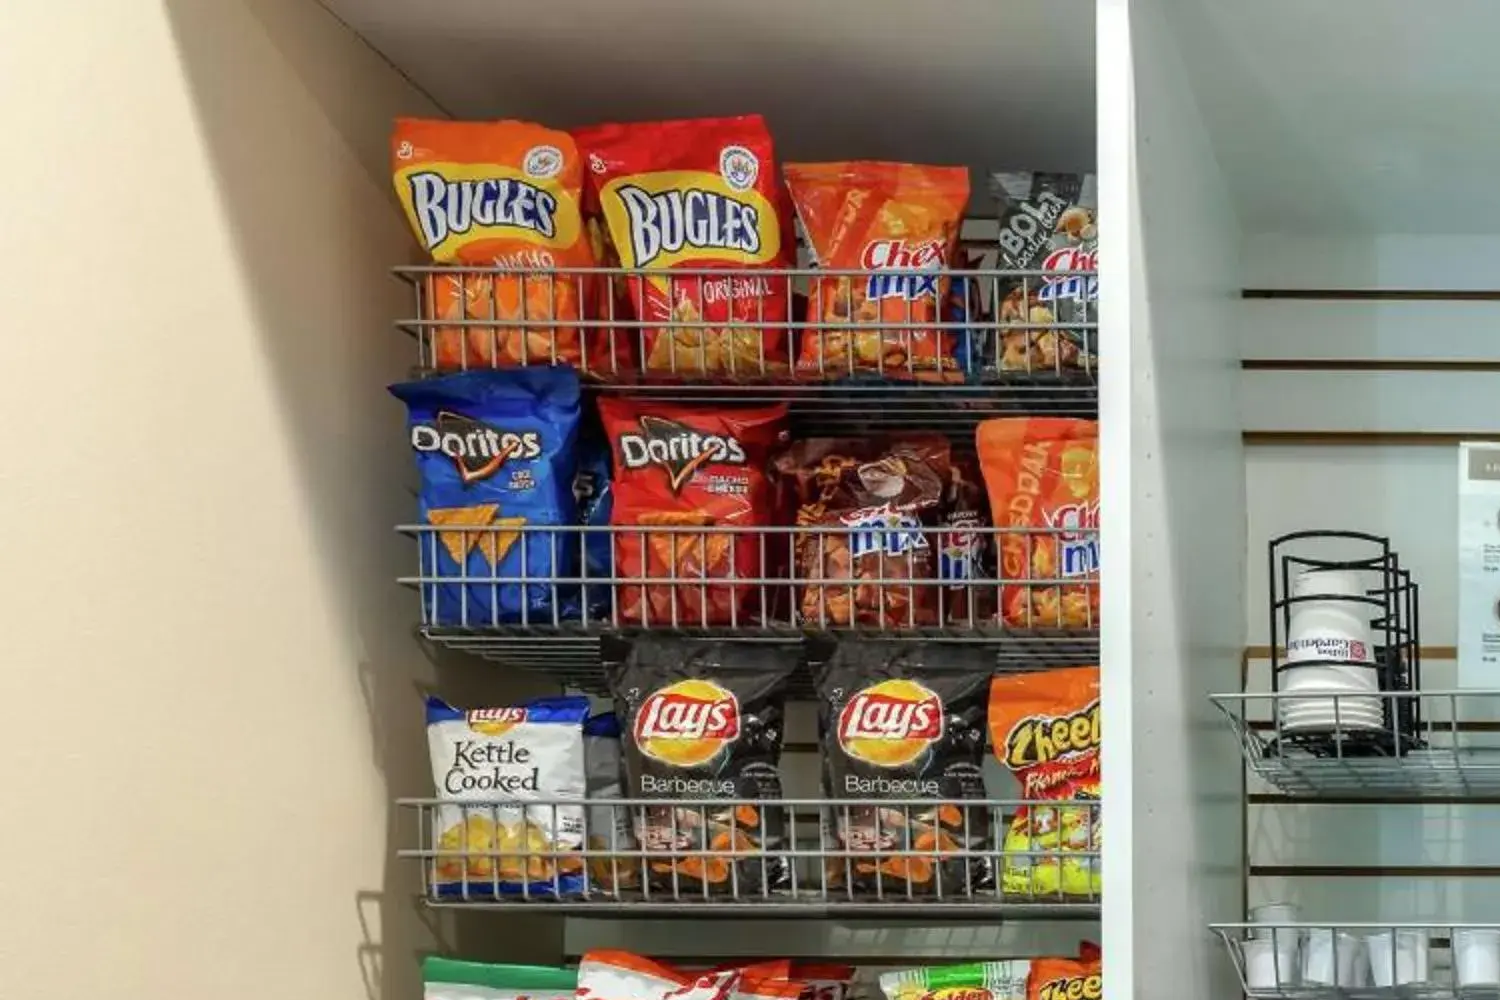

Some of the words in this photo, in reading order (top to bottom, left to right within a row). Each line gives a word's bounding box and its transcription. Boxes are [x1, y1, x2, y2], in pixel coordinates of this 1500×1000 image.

[407, 170, 556, 250] BUGLES
[615, 184, 761, 270] BUGLES
[861, 238, 946, 271] Chex
[411, 424, 541, 460] Doritos
[621, 435, 746, 468] Doritos
[641, 693, 731, 740] Lay's
[849, 693, 939, 740] Lay's
[453, 740, 531, 768] Kettle
[445, 767, 540, 795] Cooked
[640, 773, 736, 795] Barbecue
[844, 774, 940, 795] Barbecue
